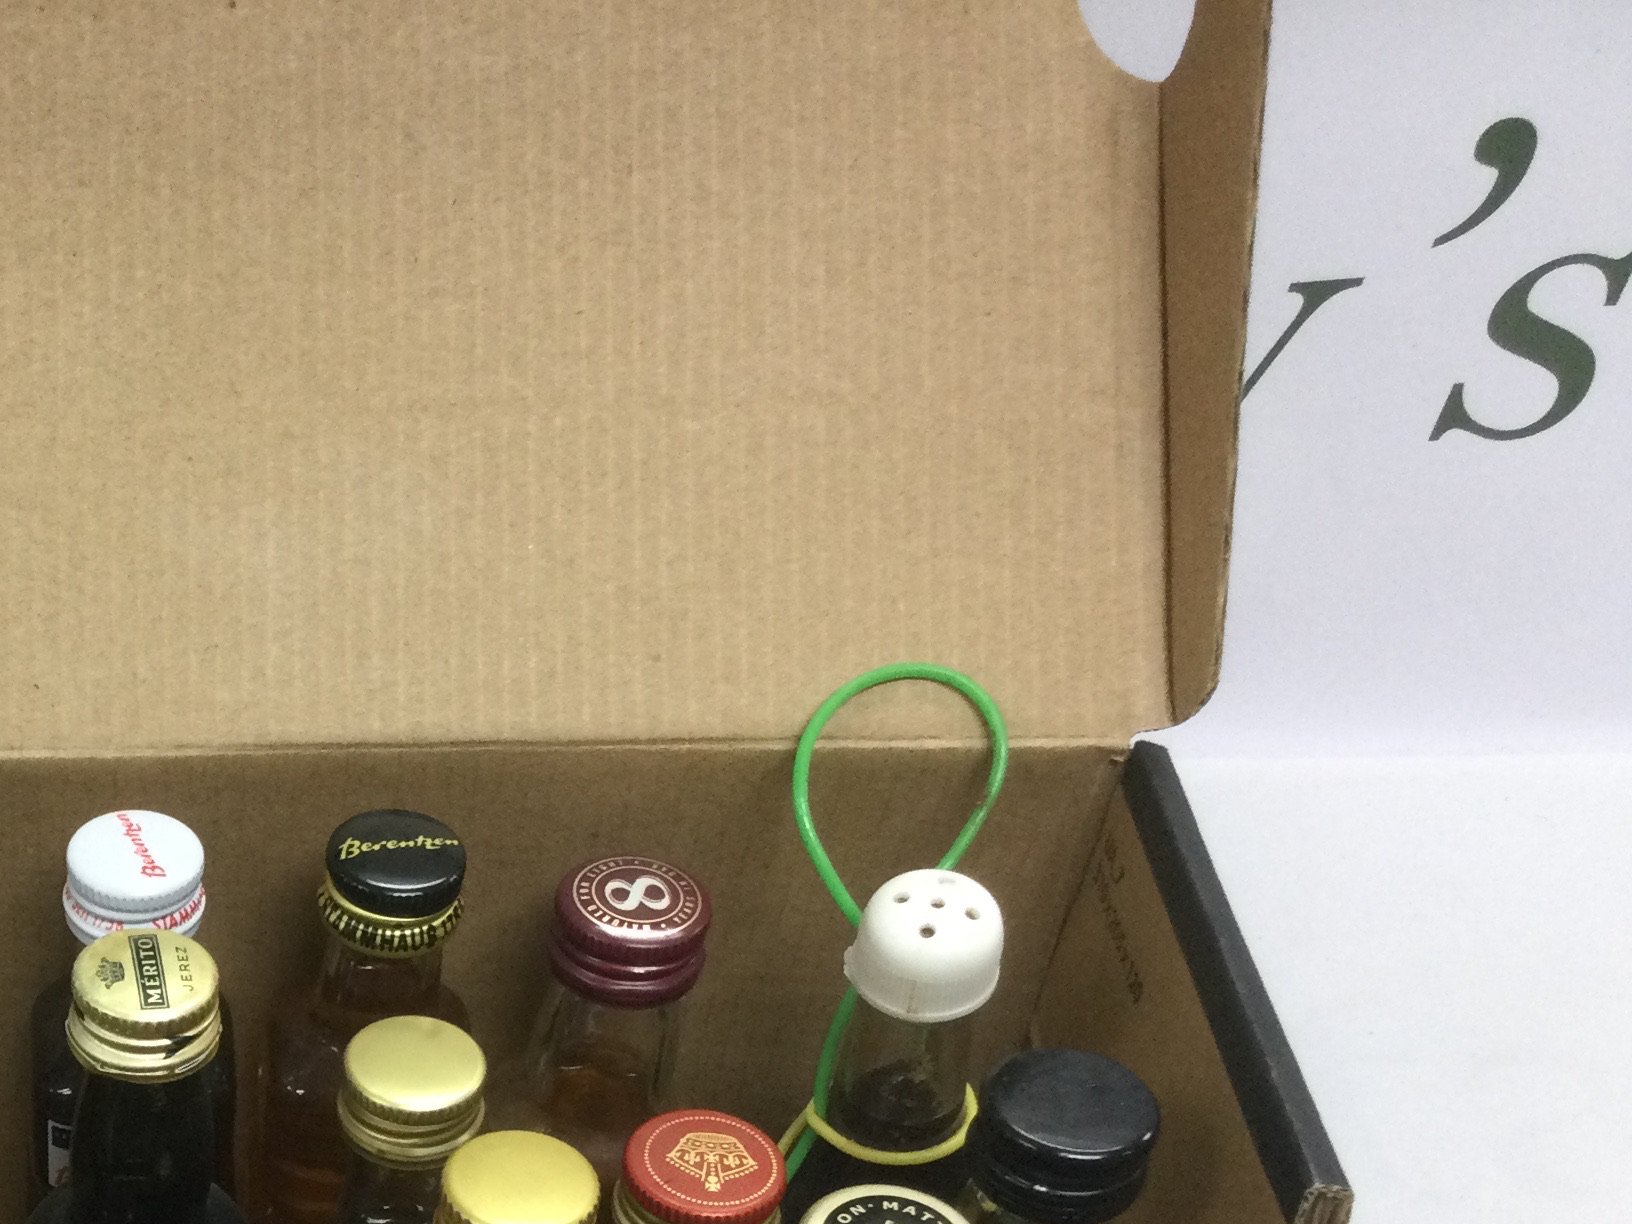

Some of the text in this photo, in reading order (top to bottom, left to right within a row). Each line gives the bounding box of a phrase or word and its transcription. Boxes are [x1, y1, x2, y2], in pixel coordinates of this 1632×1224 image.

[337, 834, 462, 862] Berentzen
[142, 937, 164, 1006] MÉRITO
[175, 946, 194, 992] JEREZ
